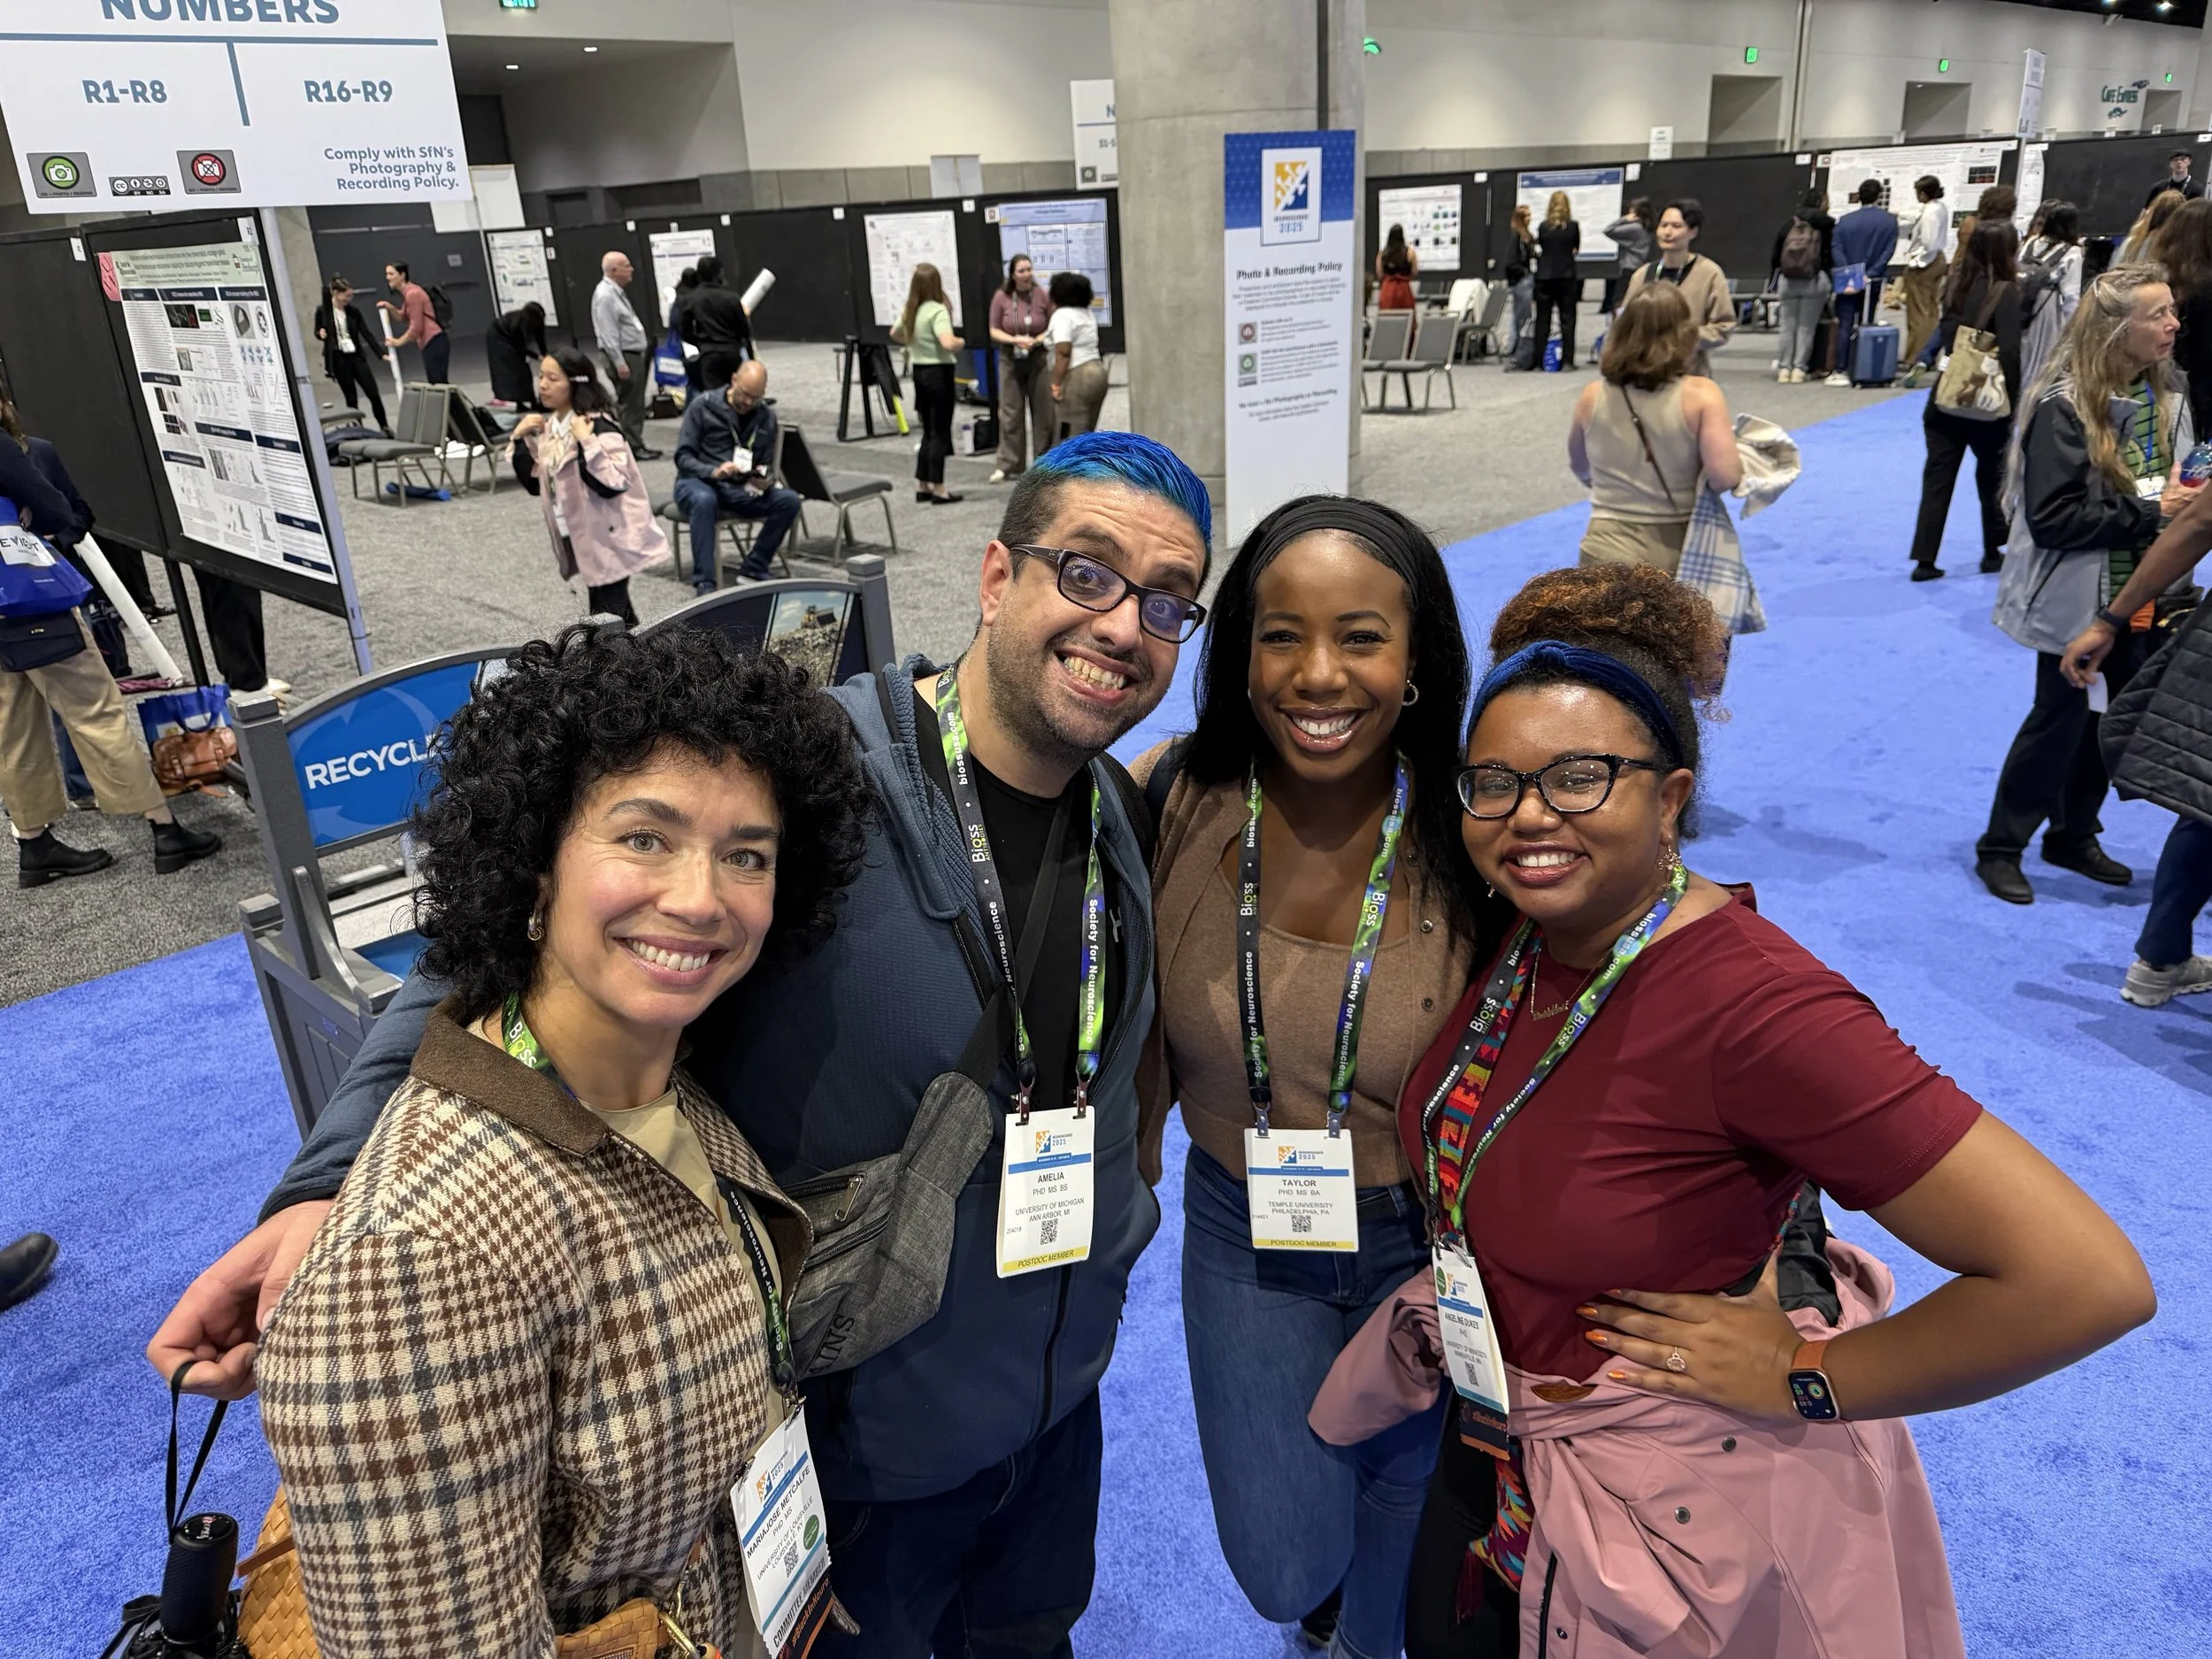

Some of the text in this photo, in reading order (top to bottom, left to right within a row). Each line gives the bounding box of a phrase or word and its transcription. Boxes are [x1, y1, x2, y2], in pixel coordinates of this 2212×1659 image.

[102, 0, 340, 24] NUMBERS
[82, 80, 167, 104] R1-R8
[304, 80, 393, 103] R16-R9
[324, 146, 454, 162] Comply with SfN's
[349, 161, 456, 176] Photography &
[337, 176, 459, 191] Recording Policy.
[947, 712, 968, 786] biossusa.com
[968, 824, 987, 863] Bioss
[1240, 882, 1254, 916] Bioss
[1366, 892, 1386, 926] Bioss
[1086, 898, 1099, 1043] Society for Neuroscience
[1245, 951, 1256, 1023] Neuroscience
[1337, 960, 1365, 1087] Society for Neuroscience
[1469, 997, 1496, 1033] Bioss
[1251, 1042, 1263, 1078] Society
[1505, 1077, 1536, 1113] Society
[1493, 1113, 1505, 1129] for
[1033, 1183, 1068, 1196] PHD MS BS
[1037, 1171, 1064, 1184] AMELIA
[1015, 1197, 1085, 1216] UNIVERSITY OF MICHIGAN
[1029, 1213, 1041, 1223] ANN
[730, 1190, 768, 1278] Neuroscience
[1018, 1249, 1074, 1268] POSTDOC MEMBER
[772, 1302, 784, 1352] Society
[747, 1508, 781, 1559] MARIAJOSE
[780, 1465, 811, 1507] METCALFE
[772, 1509, 793, 1537] PHD MS
[757, 1540, 784, 1580] UNIVERSITY
[783, 1531, 790, 1541] OF
[790, 1495, 813, 1532] LOUISVILLE
[773, 1592, 803, 1647] COMMITTEE
[803, 1557, 826, 1597] MEMBER
[792, 1578, 828, 1647] #BlackInNeuro
